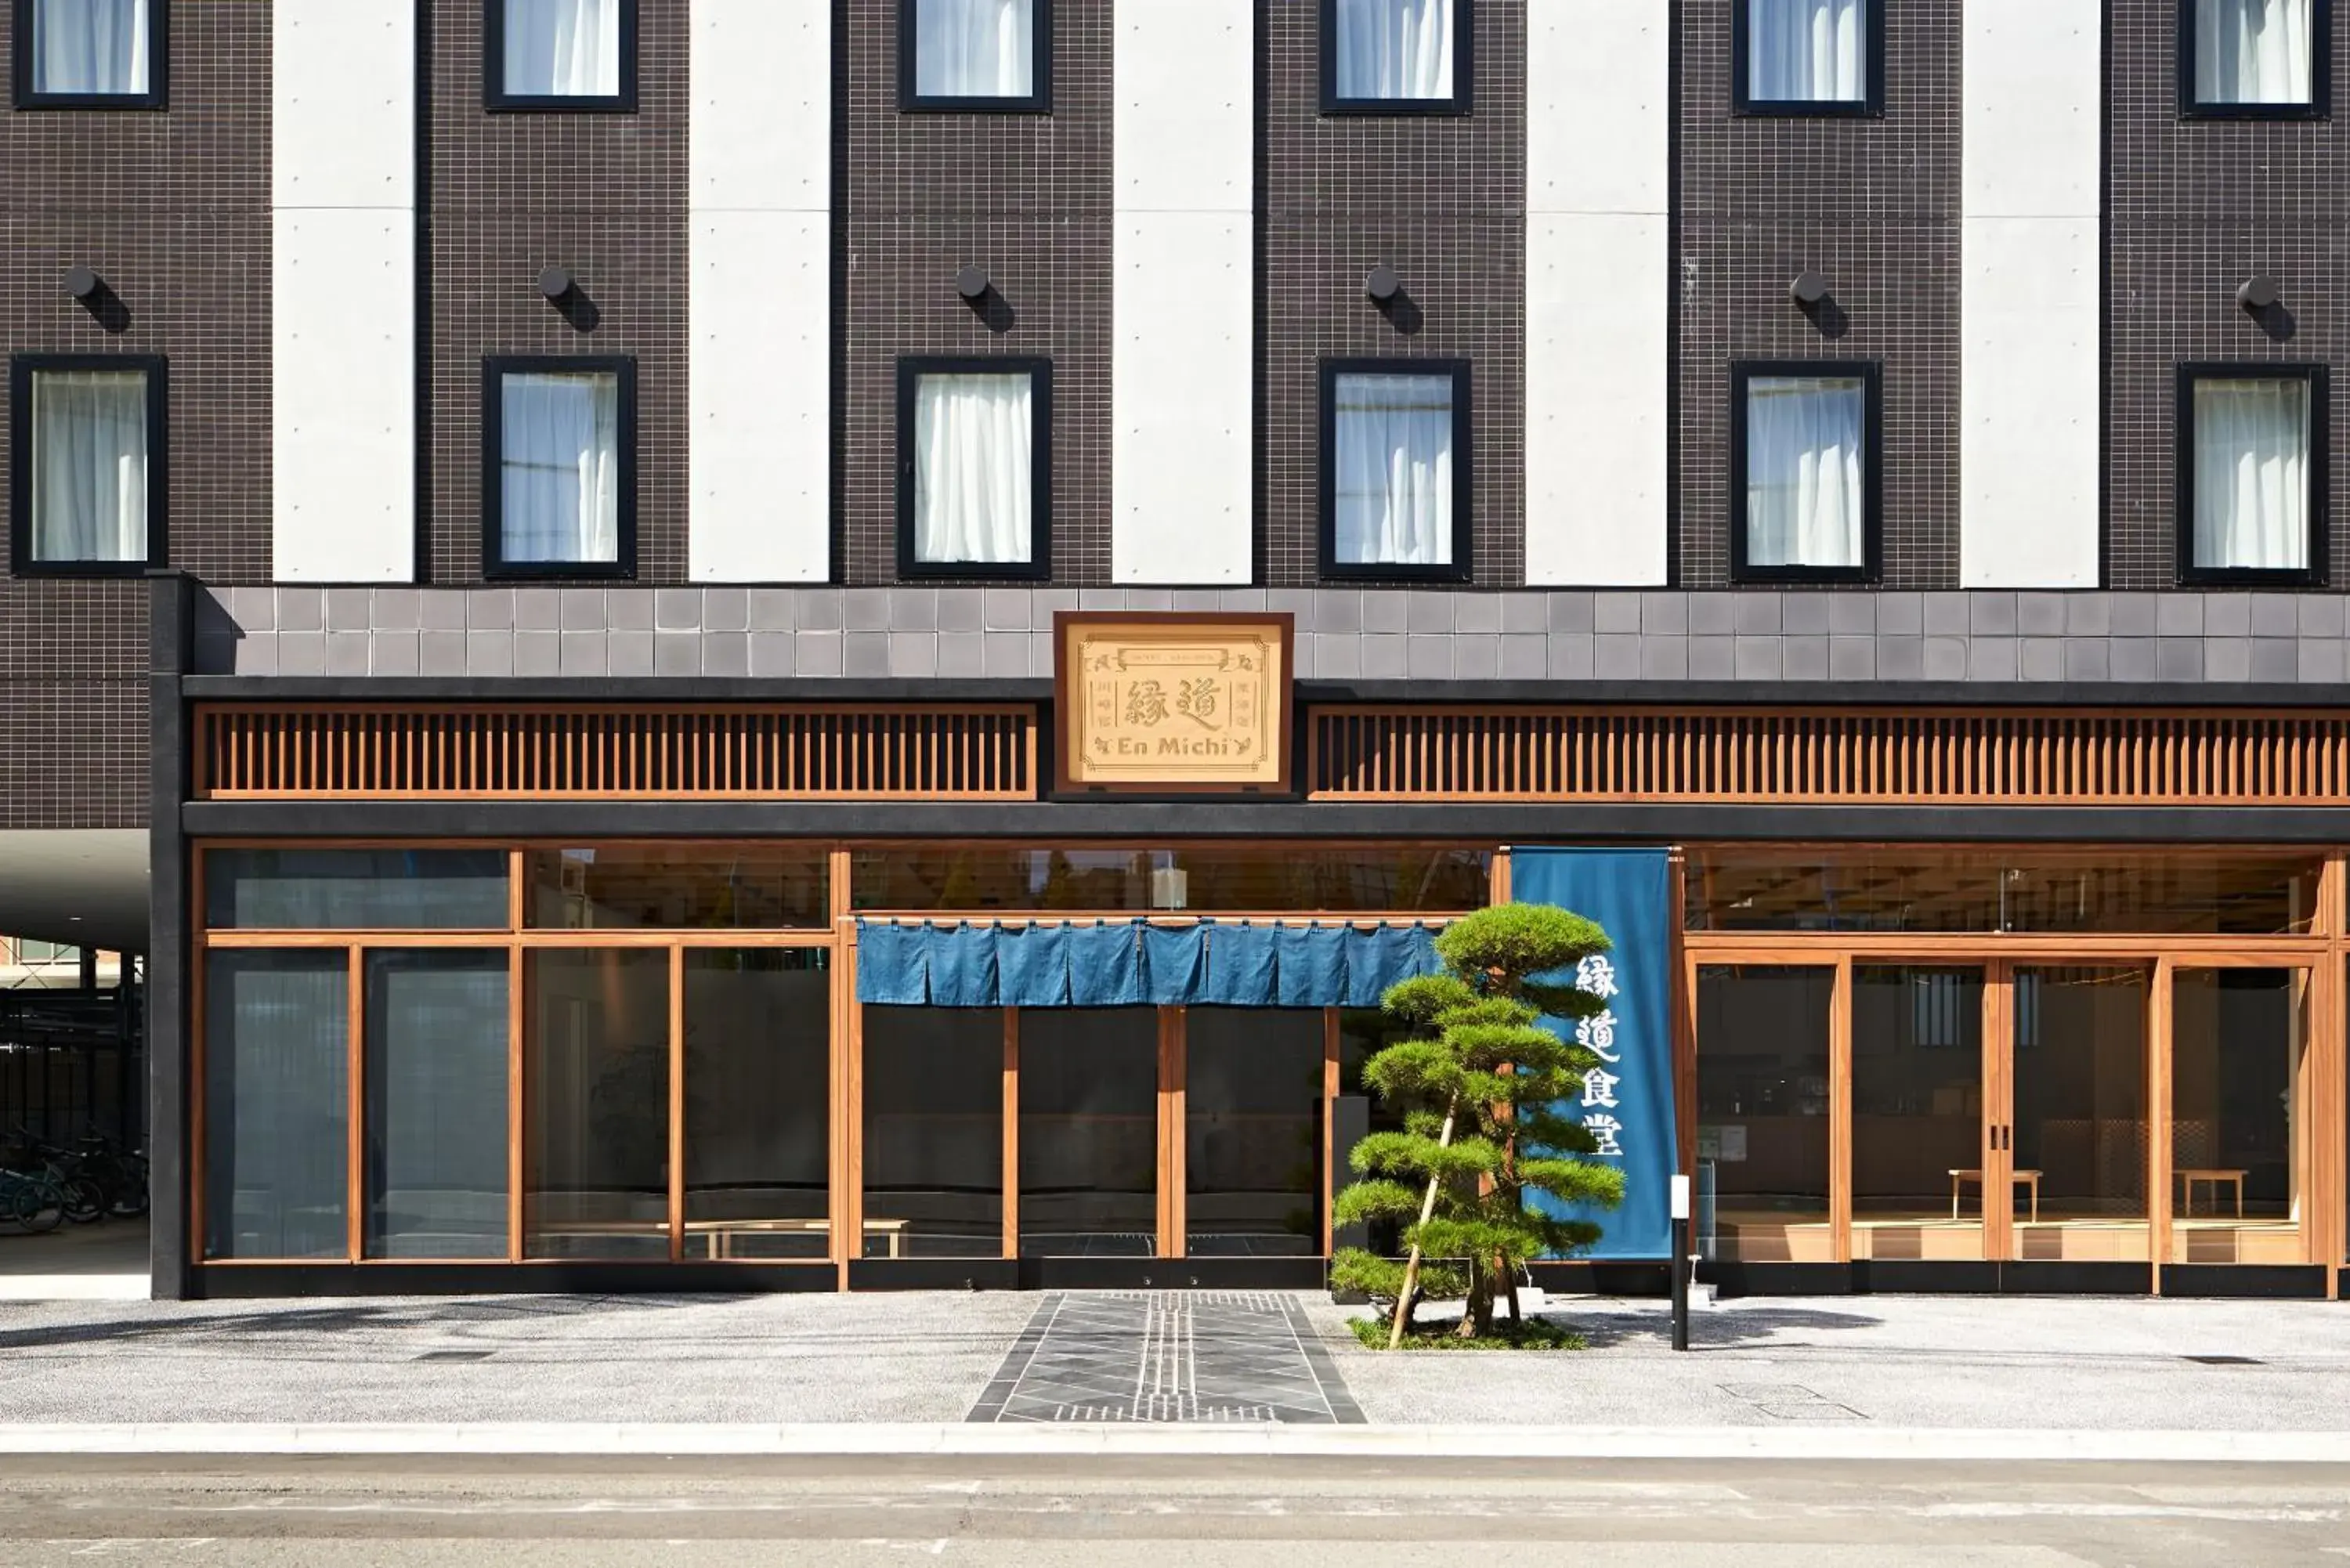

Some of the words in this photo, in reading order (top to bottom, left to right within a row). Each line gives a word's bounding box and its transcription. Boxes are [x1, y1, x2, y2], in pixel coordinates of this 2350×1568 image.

[1125, 677, 1222, 731] 縁道
[1118, 737, 1148, 755] En
[1158, 737, 1227, 755] Michi
[1575, 955, 1624, 1155] 縁道食堂
